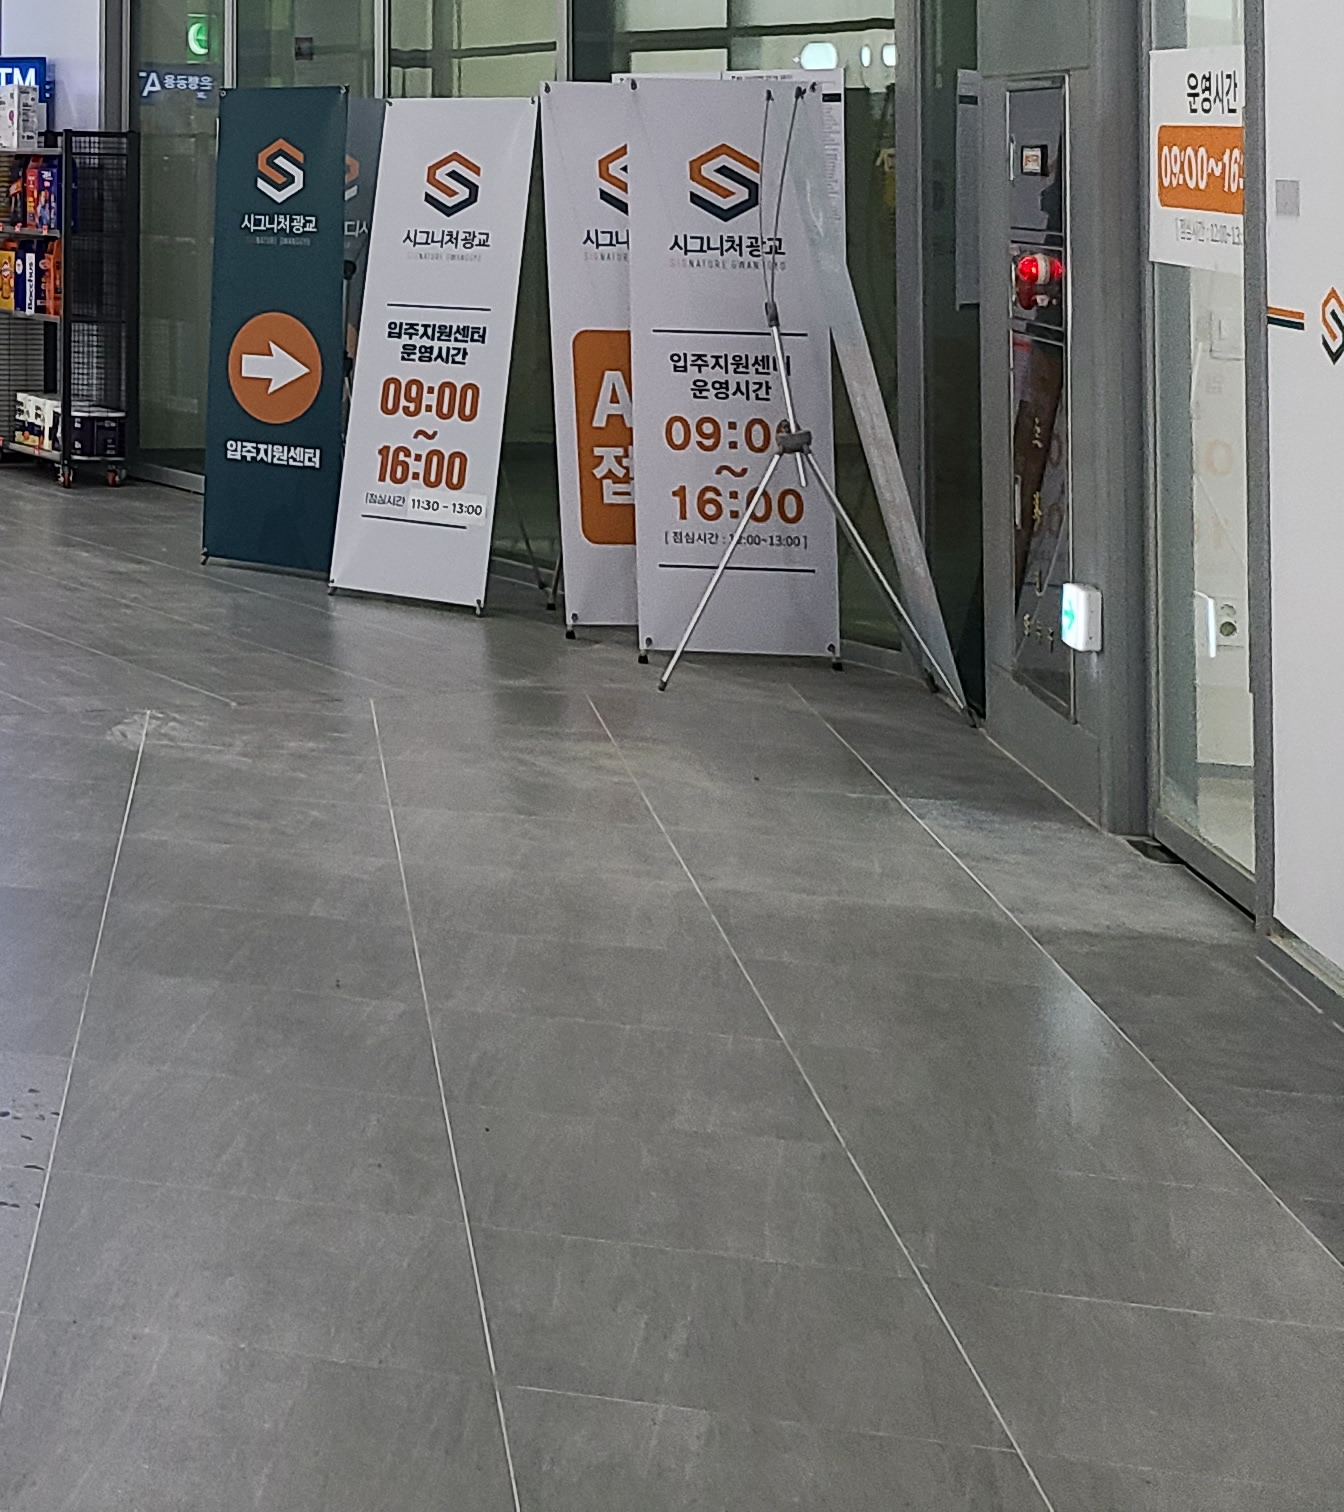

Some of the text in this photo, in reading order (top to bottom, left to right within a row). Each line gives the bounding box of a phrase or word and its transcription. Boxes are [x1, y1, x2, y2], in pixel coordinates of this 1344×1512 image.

[1186, 69, 1238, 115] 운영시간
[386, 319, 487, 345] 입주지원센터
[400, 343, 469, 366] 운영시간
[379, 376, 481, 423] 09:00
[690, 377, 773, 402] 운영시간
[664, 415, 798, 452] 09:0
[225, 439, 322, 470] 입주지원센터
[377, 444, 469, 492] 16:00
[411, 498, 440, 512] 11:30
[451, 502, 483, 517] 13:00
[671, 484, 805, 525] 16:00
